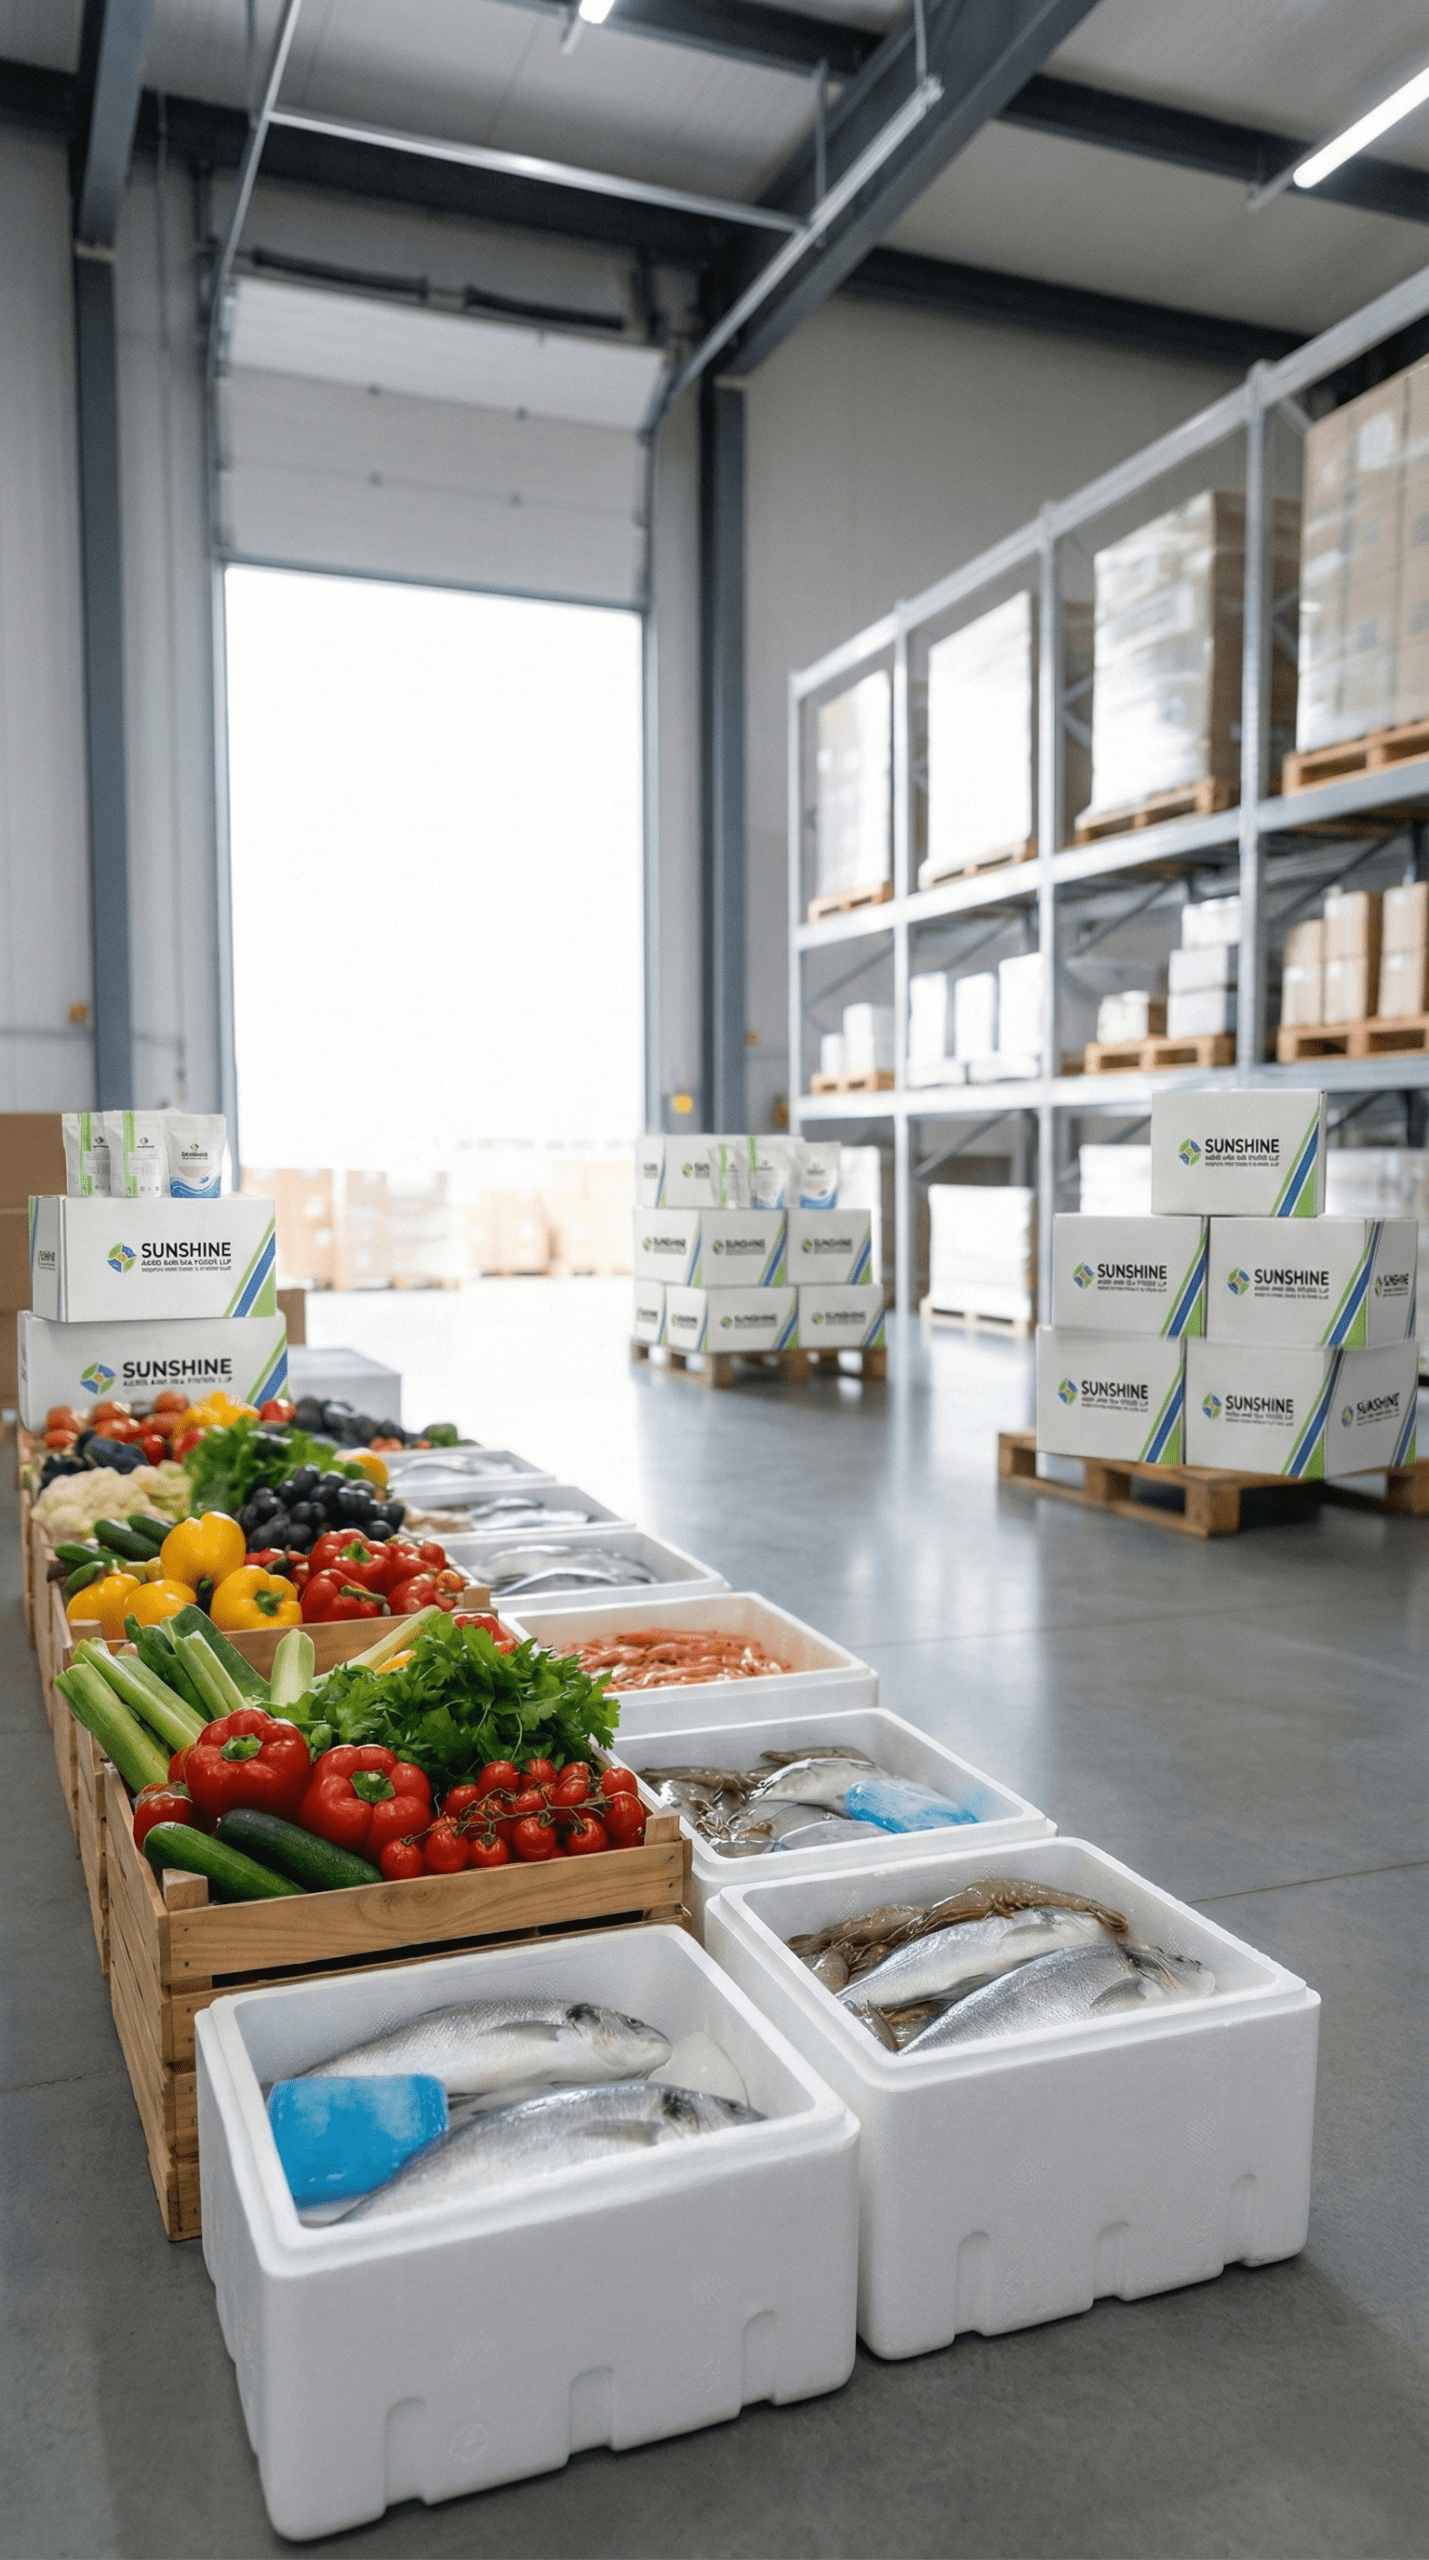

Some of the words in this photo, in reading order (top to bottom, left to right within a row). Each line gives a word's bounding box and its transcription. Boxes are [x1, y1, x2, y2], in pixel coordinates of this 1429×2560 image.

[1204, 1138, 1280, 1154] SUNSHINE
[141, 1241, 232, 1258] SUNSHINE
[1097, 1263, 1167, 1280] SUNSHINE
[1254, 1268, 1330, 1286] SUNSHINE
[122, 1358, 233, 1379] SUNSHINE
[1081, 1380, 1149, 1399] SUNSHINE
[1225, 1394, 1294, 1413] SUNSHINE
